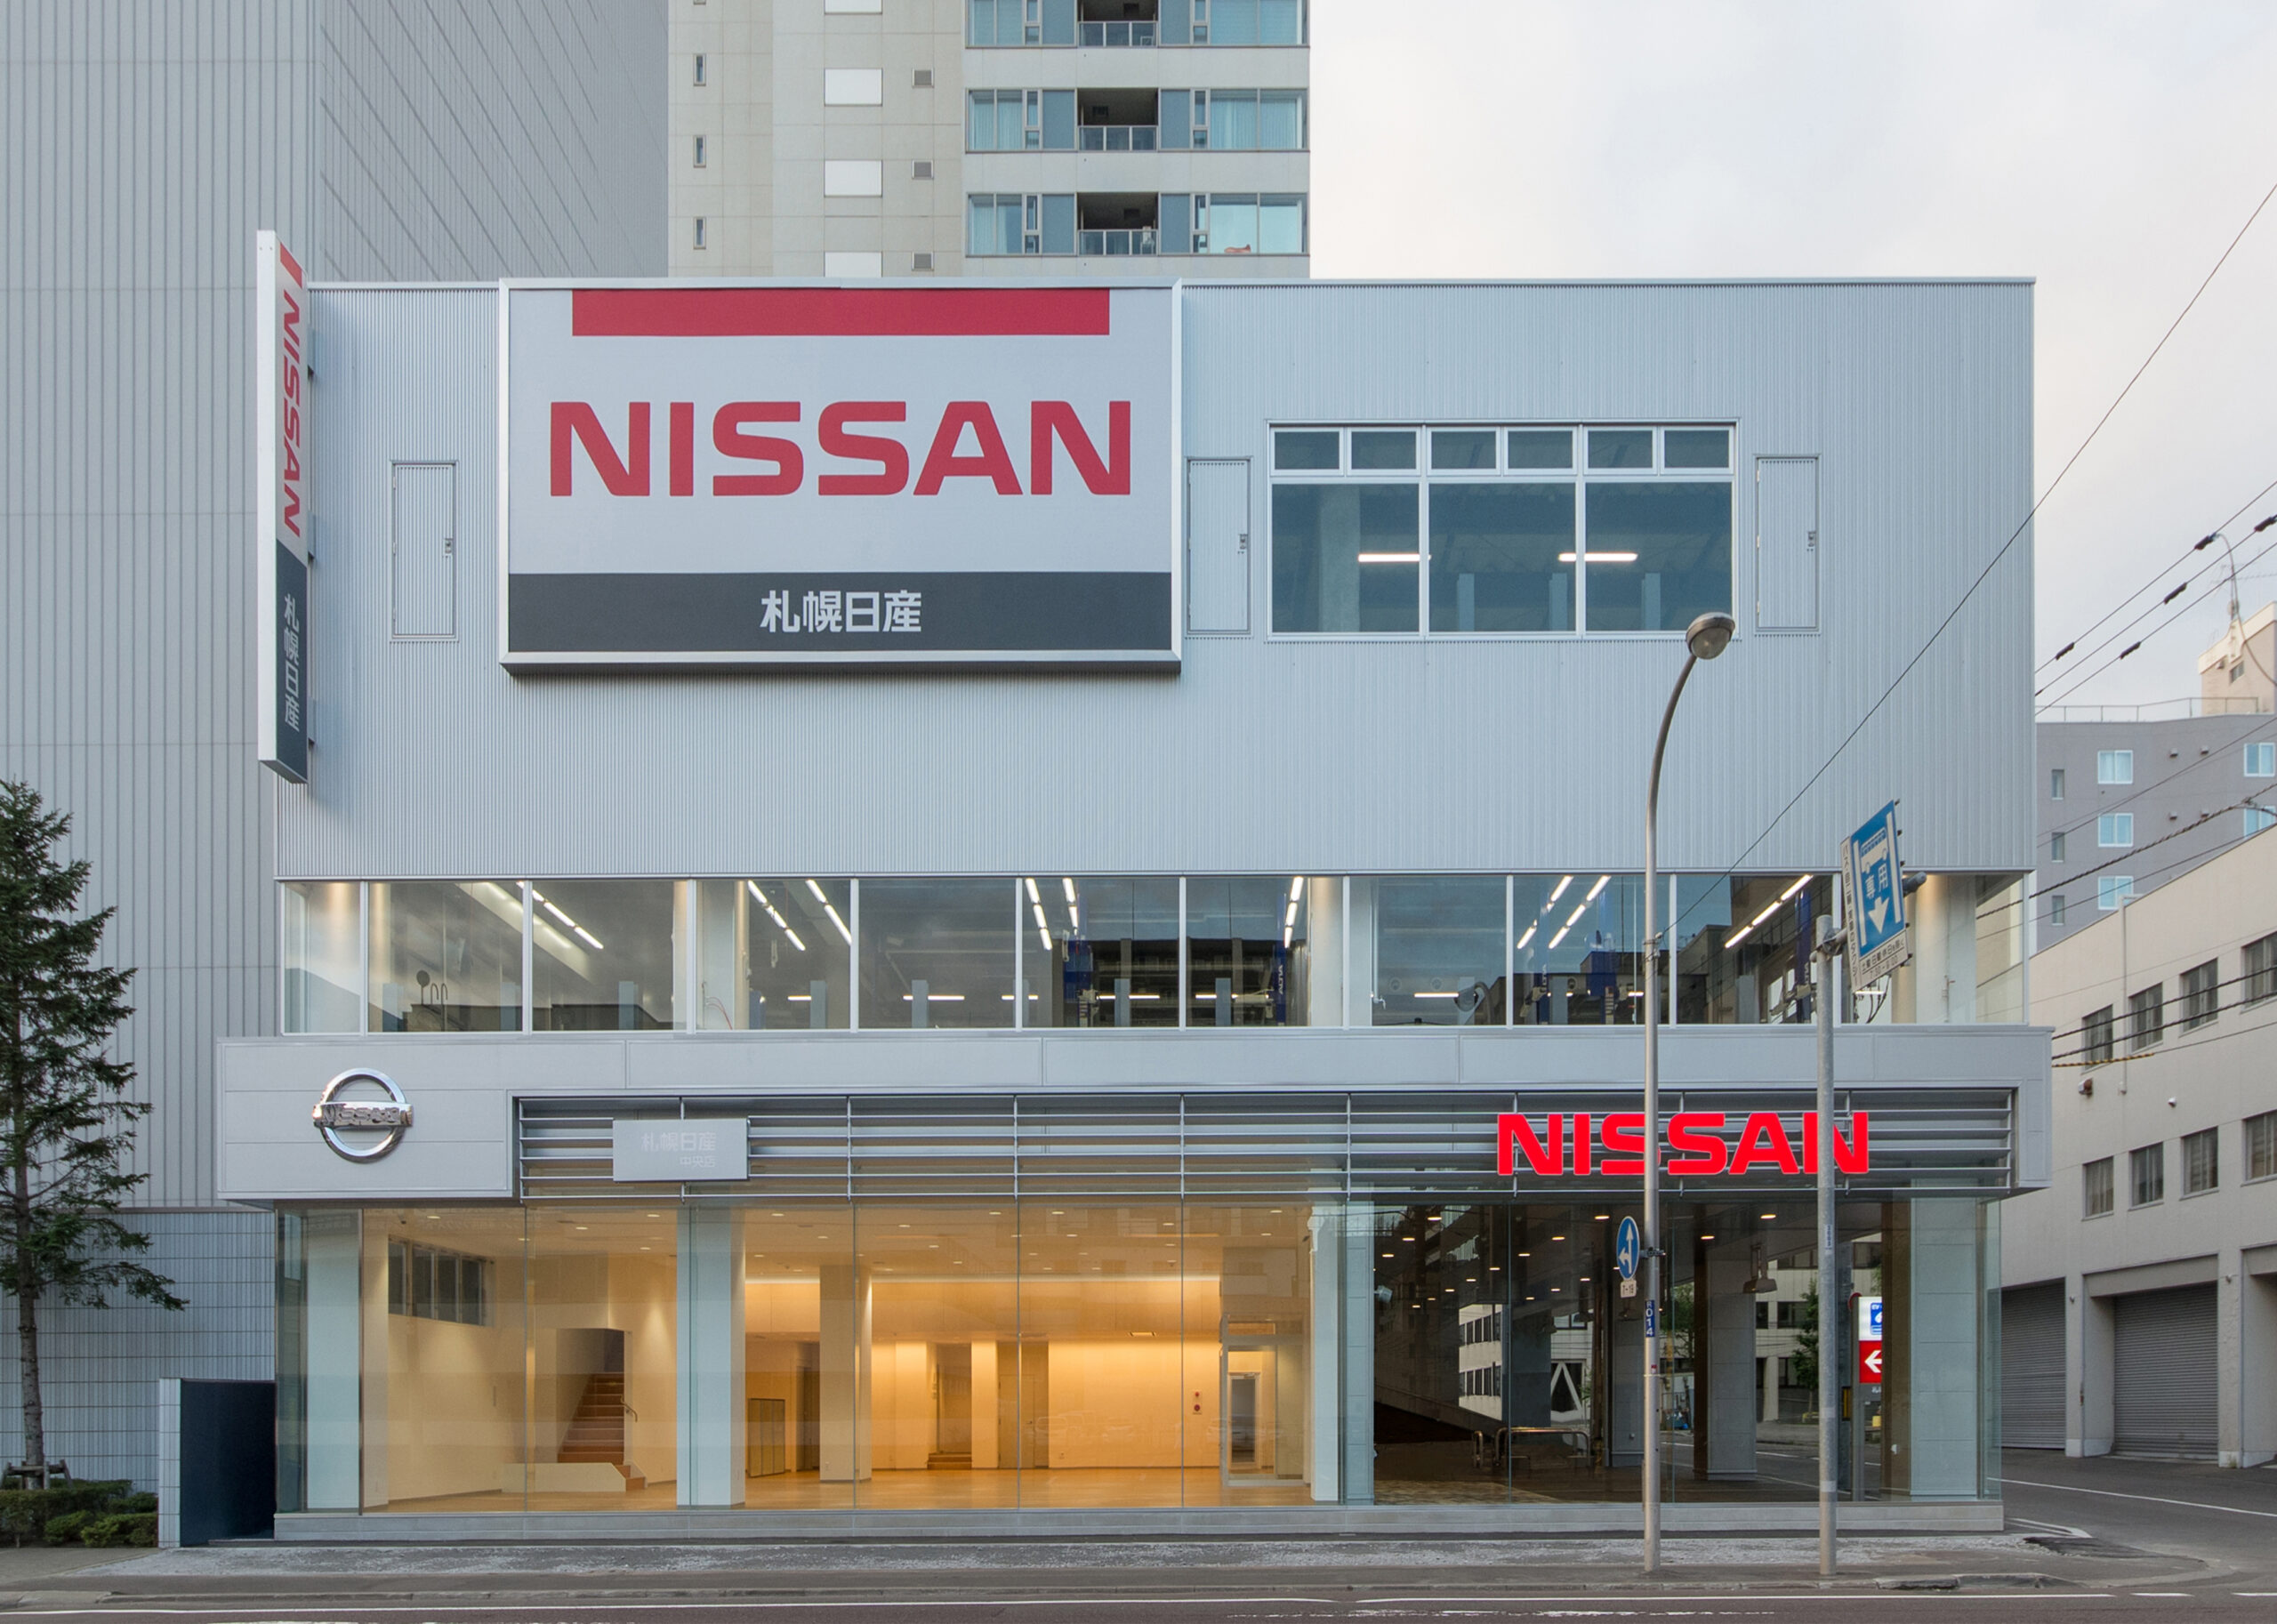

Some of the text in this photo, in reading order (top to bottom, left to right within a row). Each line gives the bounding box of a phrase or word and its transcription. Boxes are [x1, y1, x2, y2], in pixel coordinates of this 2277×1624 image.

[284, 288, 301, 538] NISSAN
[550, 400, 1131, 497] NISSAN
[760, 590, 921, 633] 札幌日産
[284, 593, 300, 733] 札幌日産
[1865, 865, 1889, 900] 専用
[640, 1131, 716, 1153] 札幌日産
[680, 1155, 716, 1168] 中央店
[1497, 1112, 1870, 1176] NISSAN
